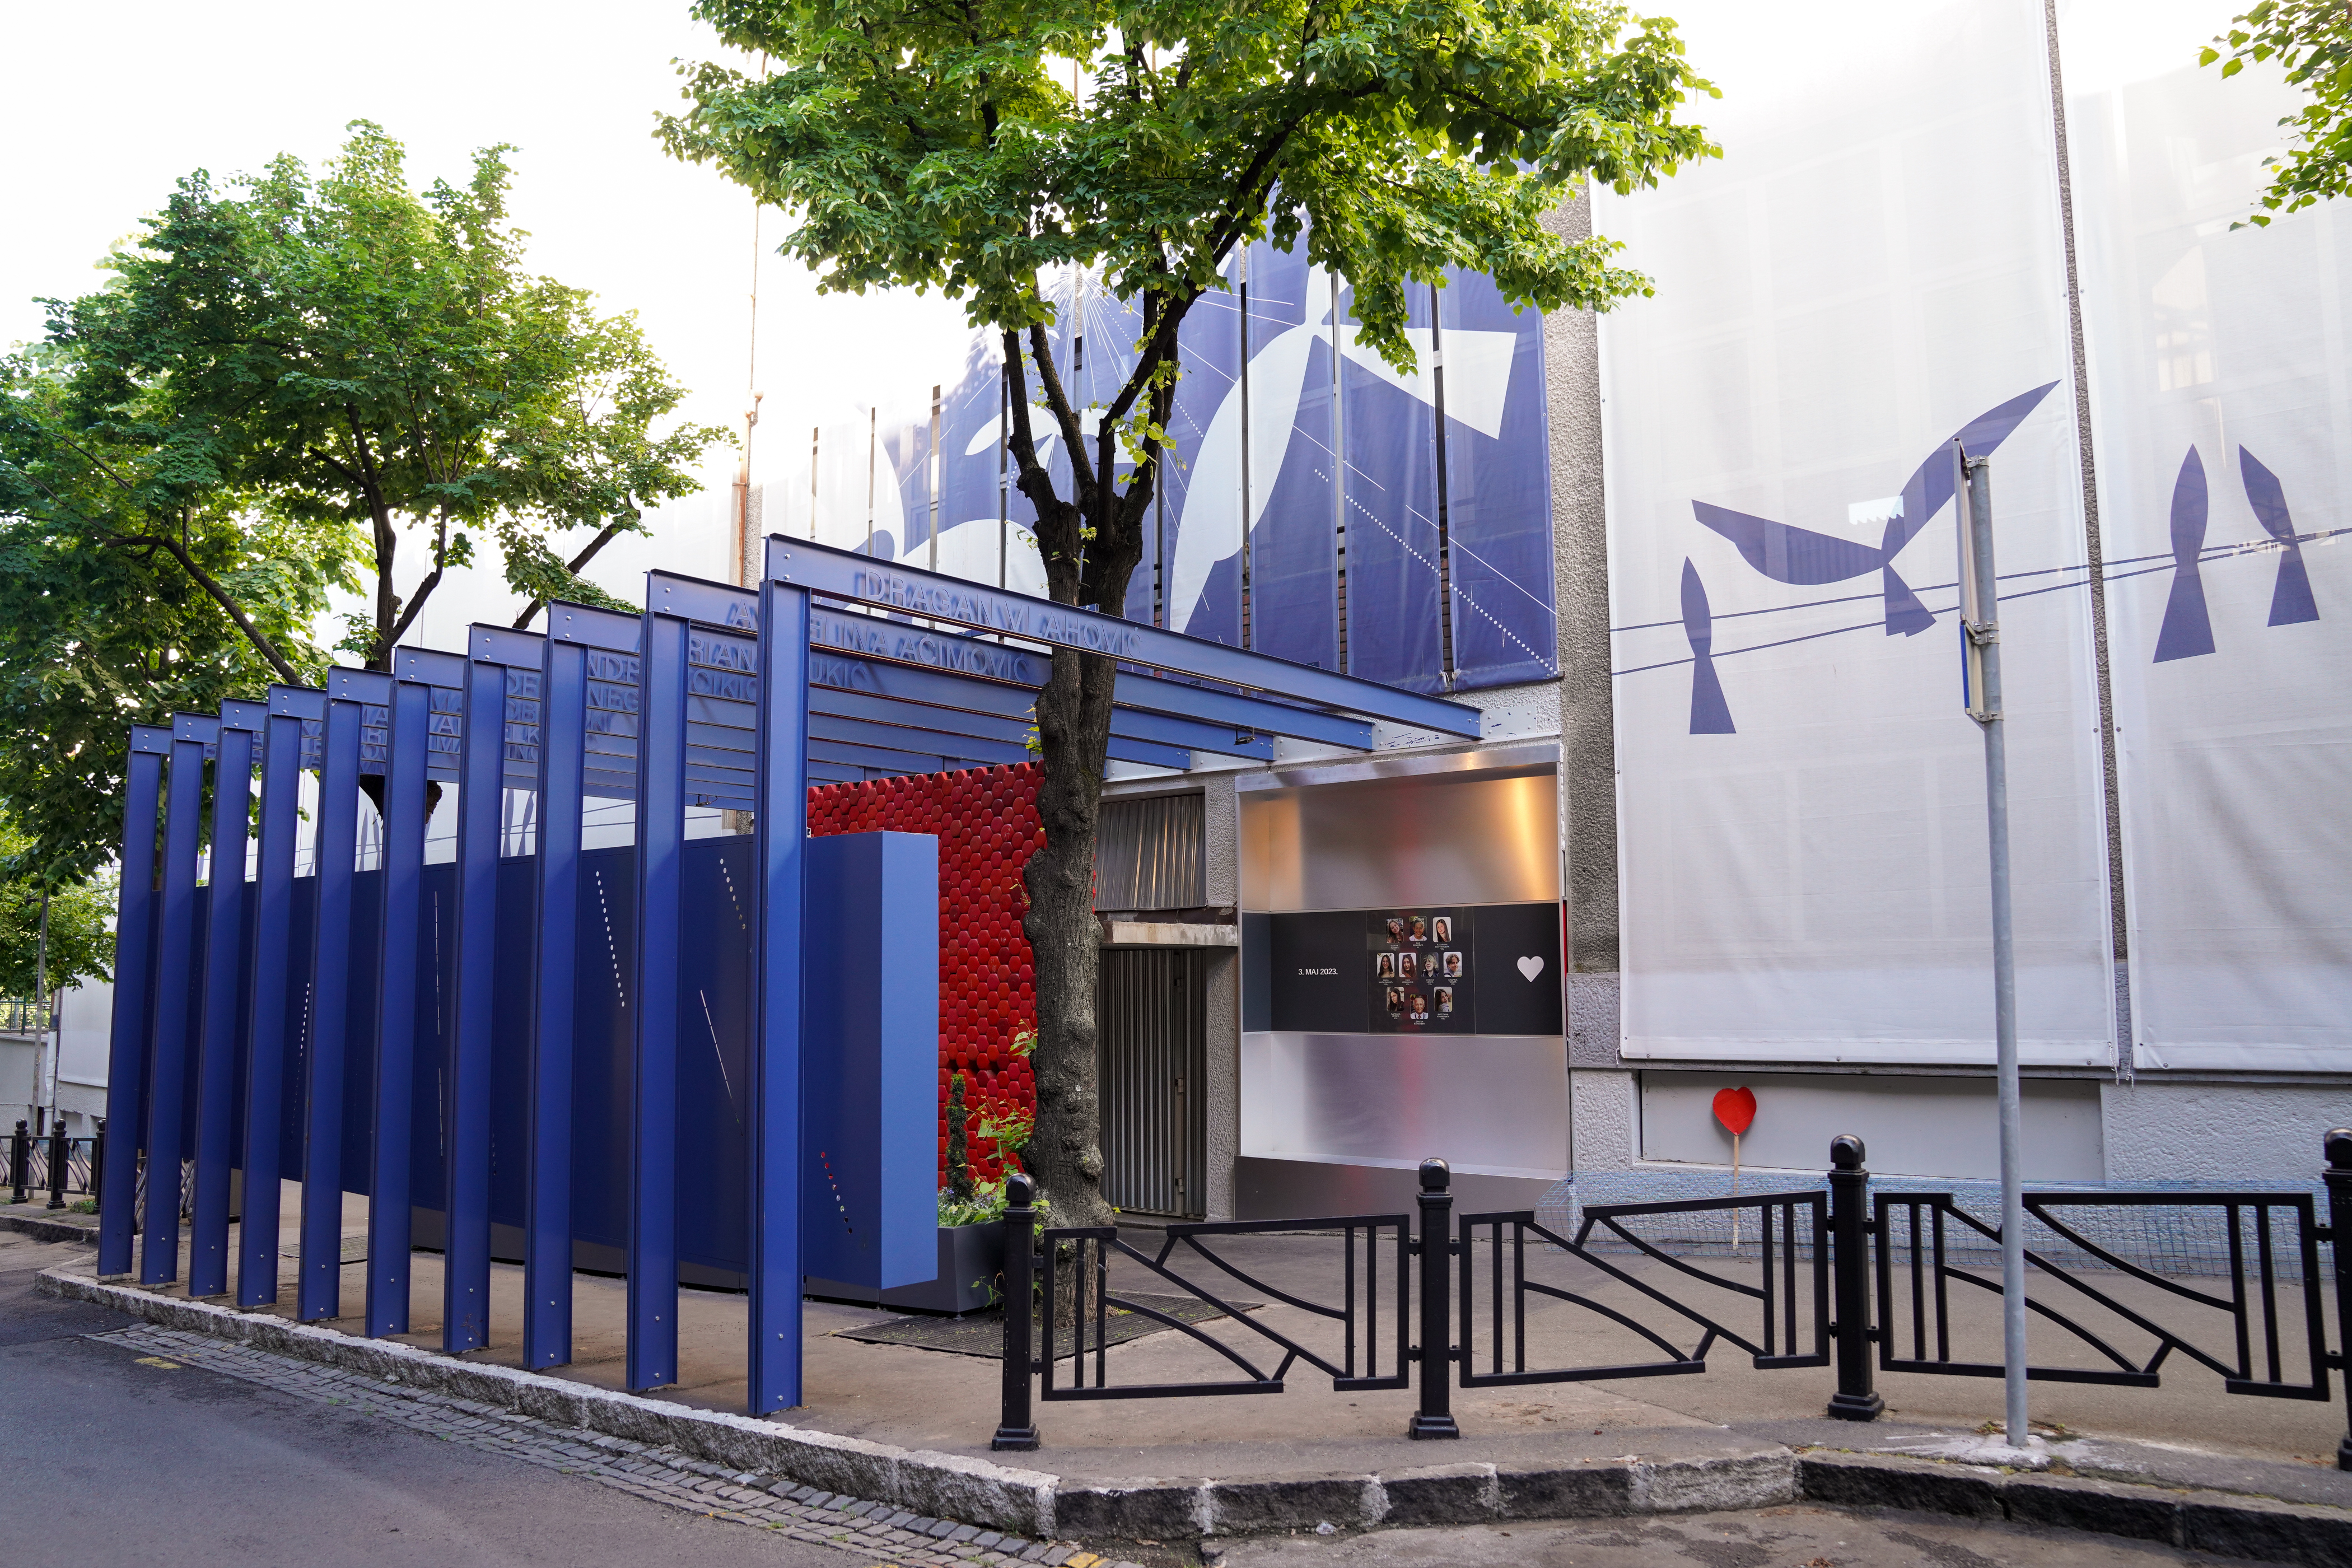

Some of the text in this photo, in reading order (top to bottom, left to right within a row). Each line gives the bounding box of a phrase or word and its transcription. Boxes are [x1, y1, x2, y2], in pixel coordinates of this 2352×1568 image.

[865, 567, 1144, 660] DRAGAN VLAHOVIĆ
[900, 631, 1030, 682] AĆIMOVIĆ
